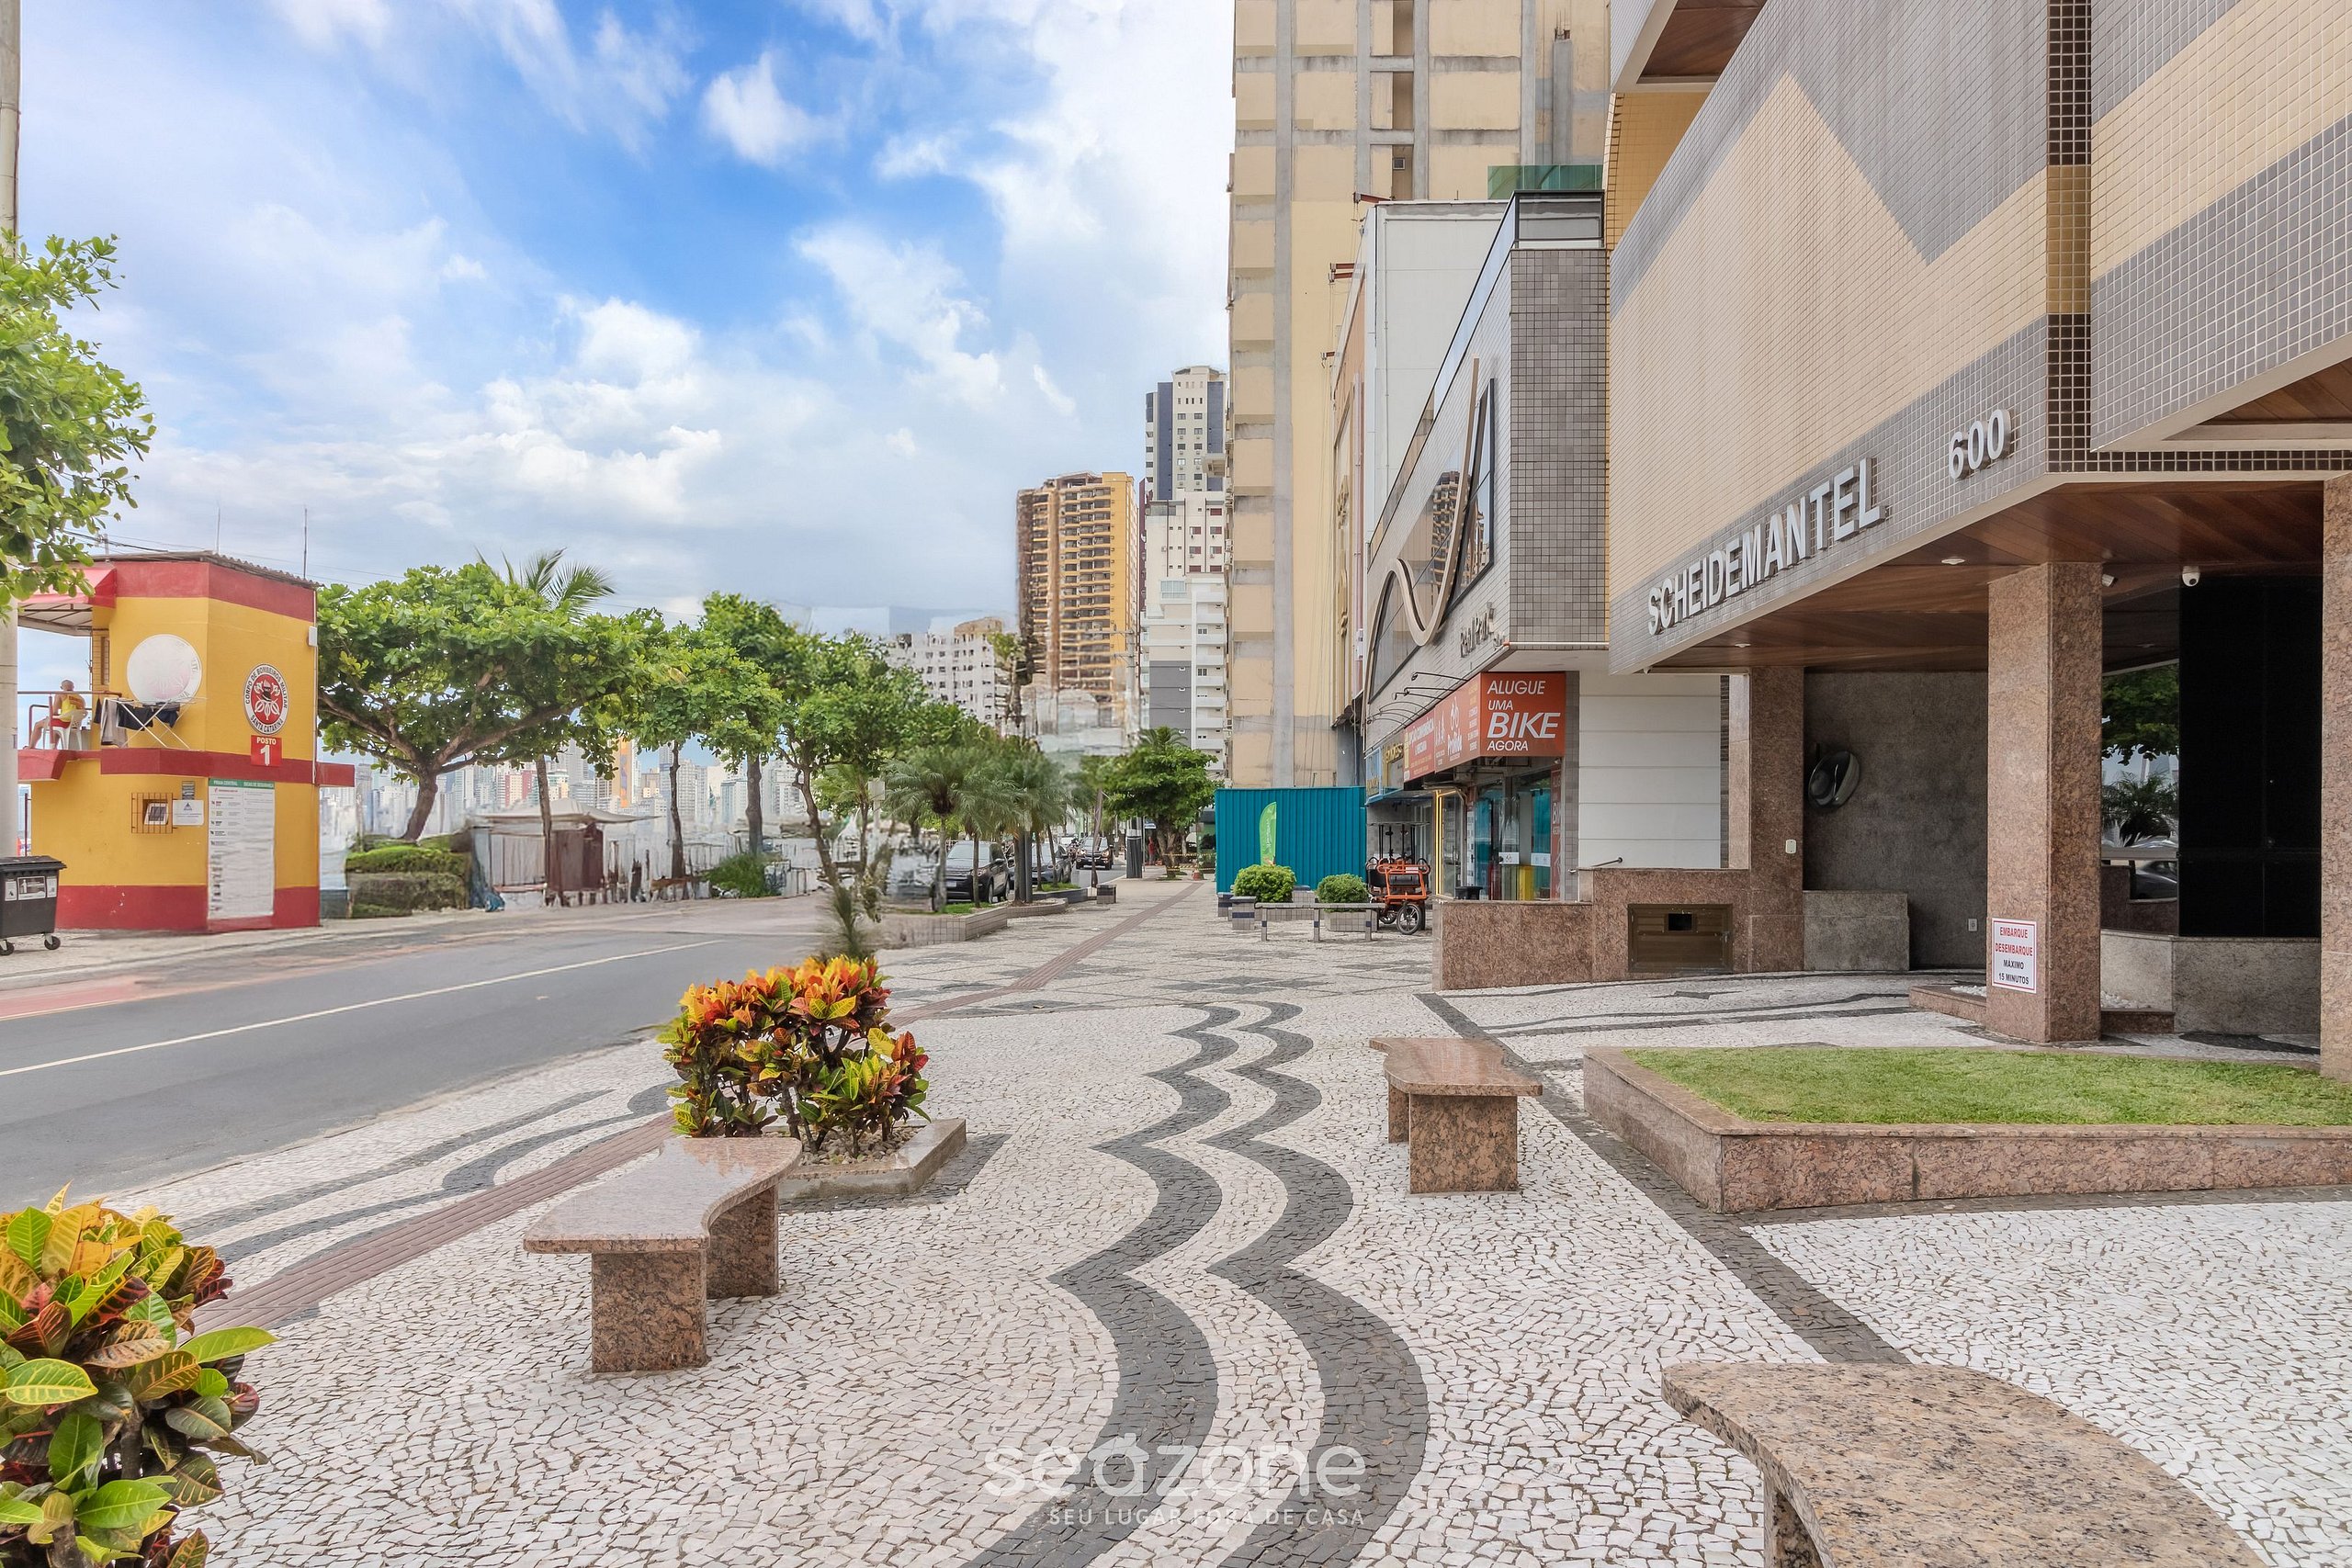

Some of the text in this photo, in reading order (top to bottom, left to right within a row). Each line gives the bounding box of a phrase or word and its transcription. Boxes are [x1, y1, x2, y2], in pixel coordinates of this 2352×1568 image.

[1948, 409, 2013, 480] 600
[1647, 457, 1886, 636] SCHEIDEMANTEL
[256, 666, 281, 682] BOMBEIROS
[279, 682, 288, 709] MILITAR
[1487, 680, 1546, 695] ALUGUE
[1487, 700, 1513, 710] UMA
[251, 715, 284, 733] SANTA CATARINA
[1487, 712, 1561, 739] BIKE
[256, 737, 277, 745] POSTO
[1487, 740, 1529, 751] AGORA
[260, 745, 270, 766] 1
[1999, 927, 2029, 939] EMBARQUE
[1995, 942, 2033, 956] DESEMBARQUE
[1998, 973, 2030, 985] 15 MINUTOS
